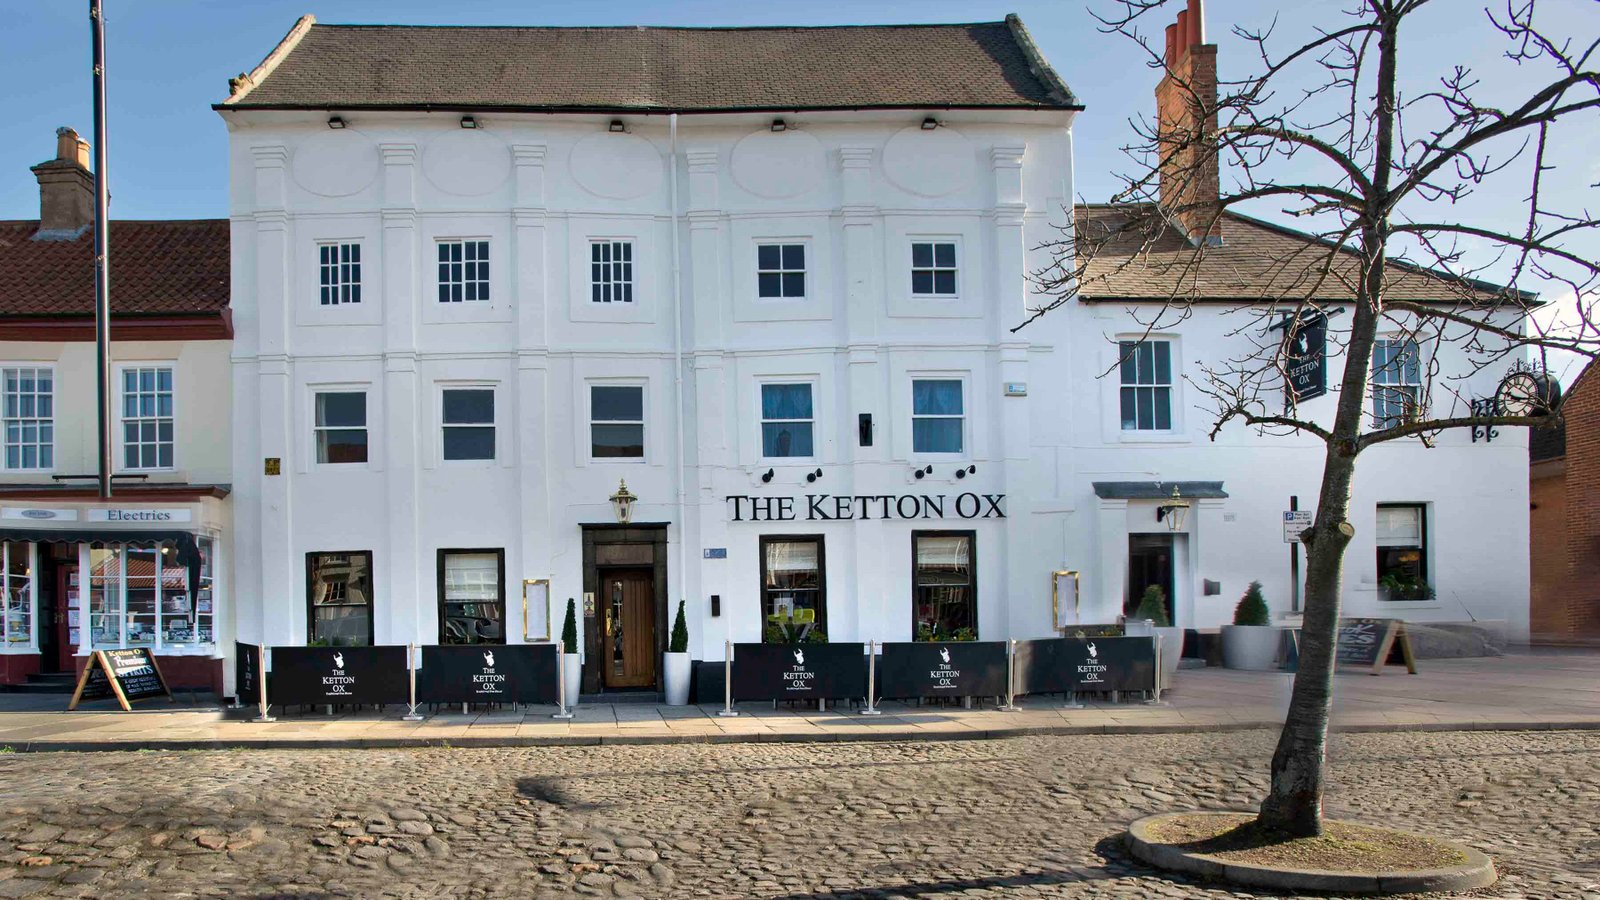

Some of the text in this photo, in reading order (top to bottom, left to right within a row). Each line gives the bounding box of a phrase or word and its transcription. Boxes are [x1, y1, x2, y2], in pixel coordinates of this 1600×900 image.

[1299, 375, 1310, 384] OX
[726, 493, 1006, 520] THE KETTON OX
[108, 510, 170, 520] Electrics
